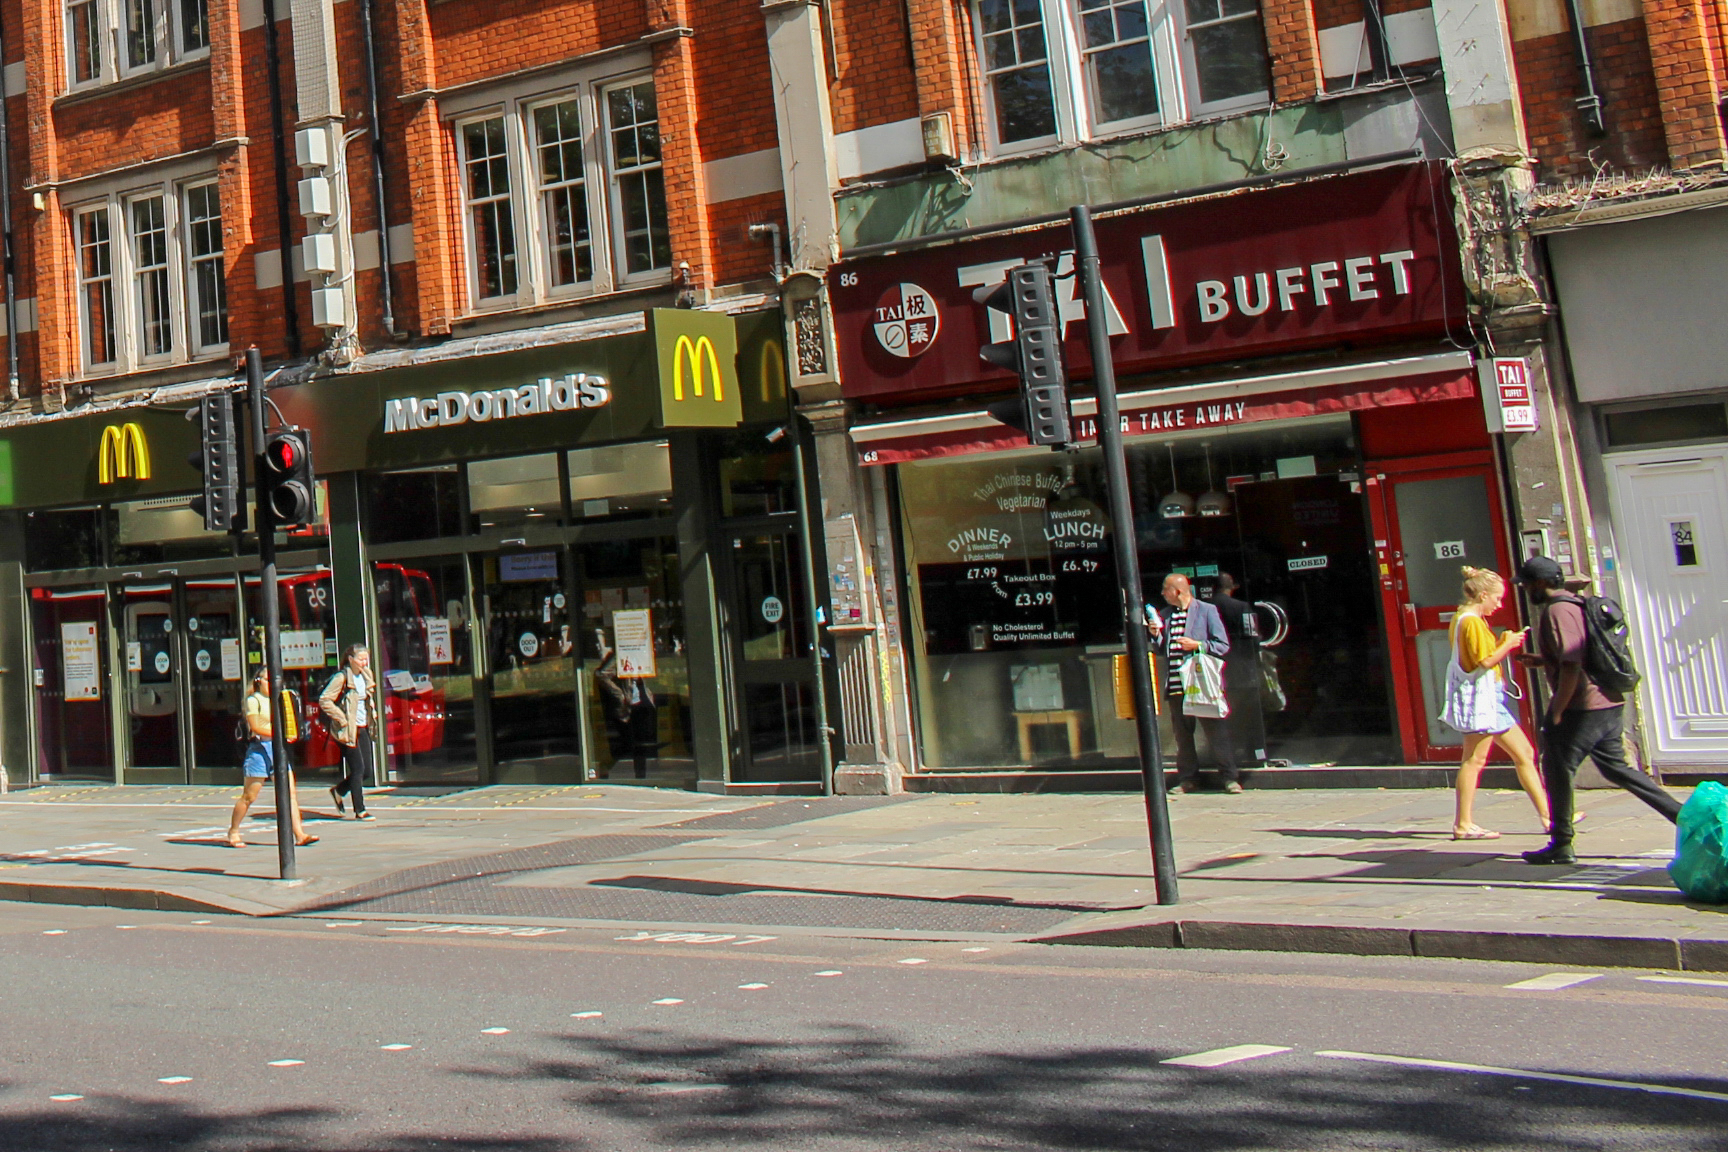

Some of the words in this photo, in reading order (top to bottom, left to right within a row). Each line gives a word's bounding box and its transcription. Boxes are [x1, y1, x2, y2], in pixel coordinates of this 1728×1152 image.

[840, 272, 858, 286] 86
[1196, 249, 1415, 323] BUFFET
[906, 294, 926, 316] 极
[876, 305, 903, 321] TAI
[909, 322, 929, 344] 素
[1498, 365, 1520, 384] TAI
[1504, 389, 1522, 398] BUFFET
[384, 373, 611, 433] McDonald's
[1140, 410, 1184, 431] TAKE
[1195, 402, 1246, 424] AWAY
[1507, 409, 1528, 422] £3.99
[864, 451, 878, 462] 68
[974, 482, 996, 502] Thai
[994, 472, 1031, 489] Chinese
[1035, 473, 1065, 495] Buffet
[996, 493, 1046, 512] Vegetarian
[1050, 508, 1091, 519] Weekdays
[1043, 522, 1105, 541] LUNCH
[1675, 530, 1693, 544] 84
[947, 527, 1012, 553] DINNER
[985, 553, 1004, 561] Holiday
[1441, 544, 1460, 557] 86
[1290, 557, 1326, 569] CLOSED
[967, 567, 998, 580] £7.99
[1003, 574, 1038, 582] Takeout
[1040, 573, 1056, 581] Box
[991, 581, 1008, 598] from
[1015, 592, 1054, 607] £3.99
[1004, 623, 1044, 631] Cholesterol
[993, 633, 1017, 642] Quality
[1018, 632, 1051, 640] Unlimited
